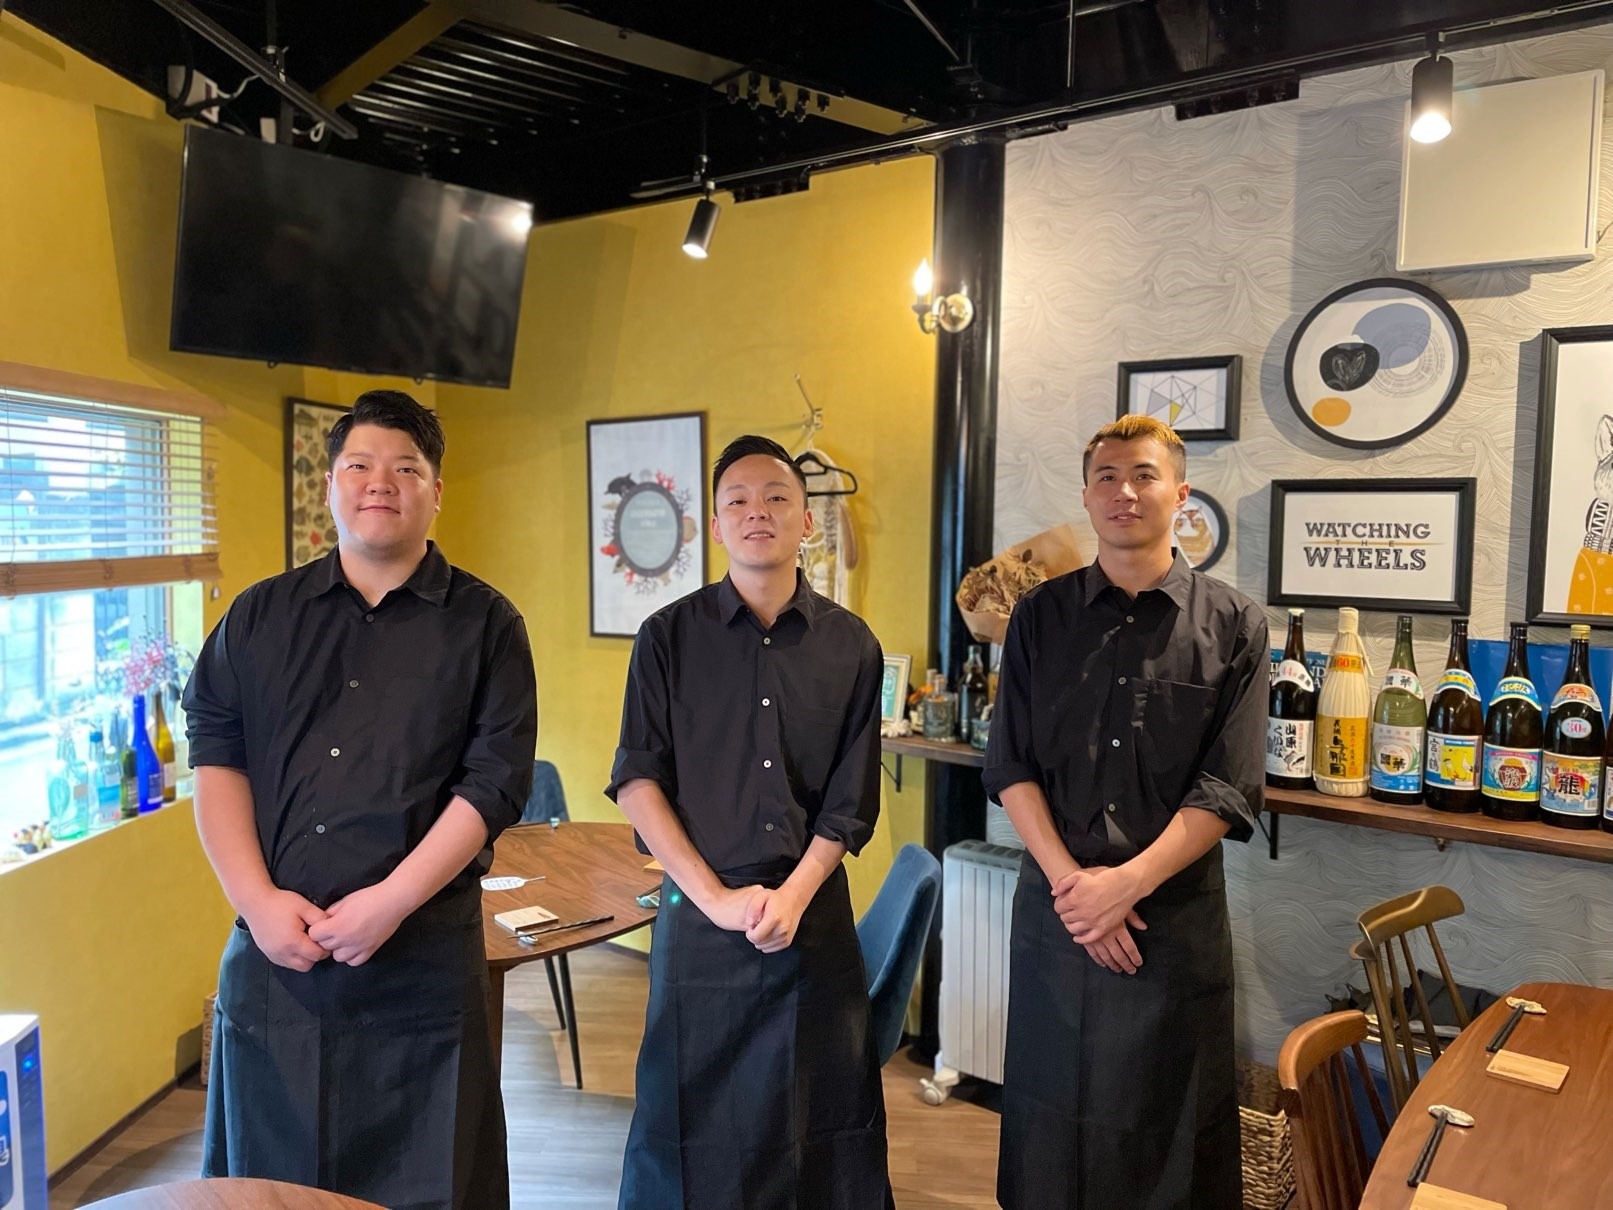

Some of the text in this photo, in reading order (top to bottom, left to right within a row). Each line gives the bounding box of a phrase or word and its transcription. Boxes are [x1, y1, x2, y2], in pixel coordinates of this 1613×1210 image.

[1305, 522, 1431, 539] WATCHING
[1303, 546, 1427, 571] WHEELS
[1285, 723, 1297, 748] 山原
[1558, 774, 1580, 795] 龍
